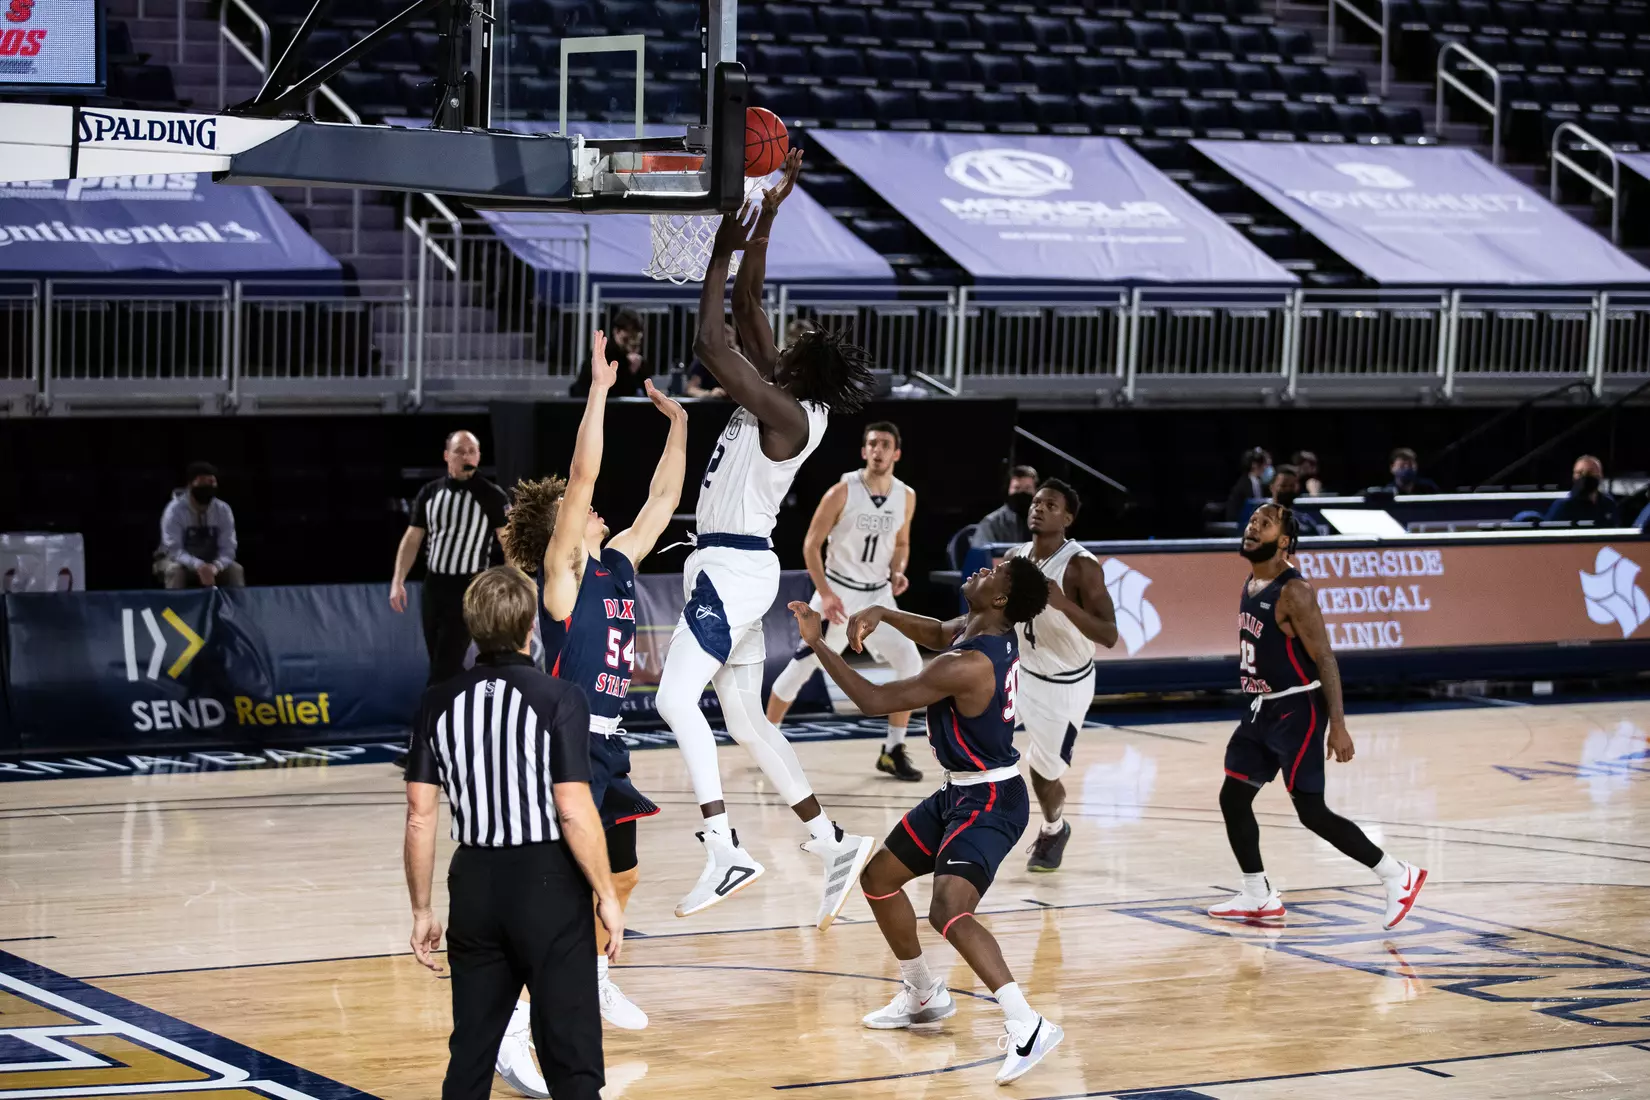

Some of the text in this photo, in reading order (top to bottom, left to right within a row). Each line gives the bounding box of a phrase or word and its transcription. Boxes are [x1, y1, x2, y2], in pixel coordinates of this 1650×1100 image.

[0, 29, 48, 56] OS
[78, 111, 217, 150] SPALDING
[0, 219, 227, 247] ontinental
[857, 513, 897, 533] CBU
[860, 534, 880, 562] 11
[1296, 550, 1444, 579] RIVERSIDE
[603, 598, 636, 624] DIX
[605, 626, 636, 673] 54
[1325, 620, 1404, 651] LINIC
[1240, 640, 1256, 674] 12
[595, 672, 632, 698] STAT
[1240, 676, 1272, 693] TATE
[131, 692, 331, 732] SEND Relief
